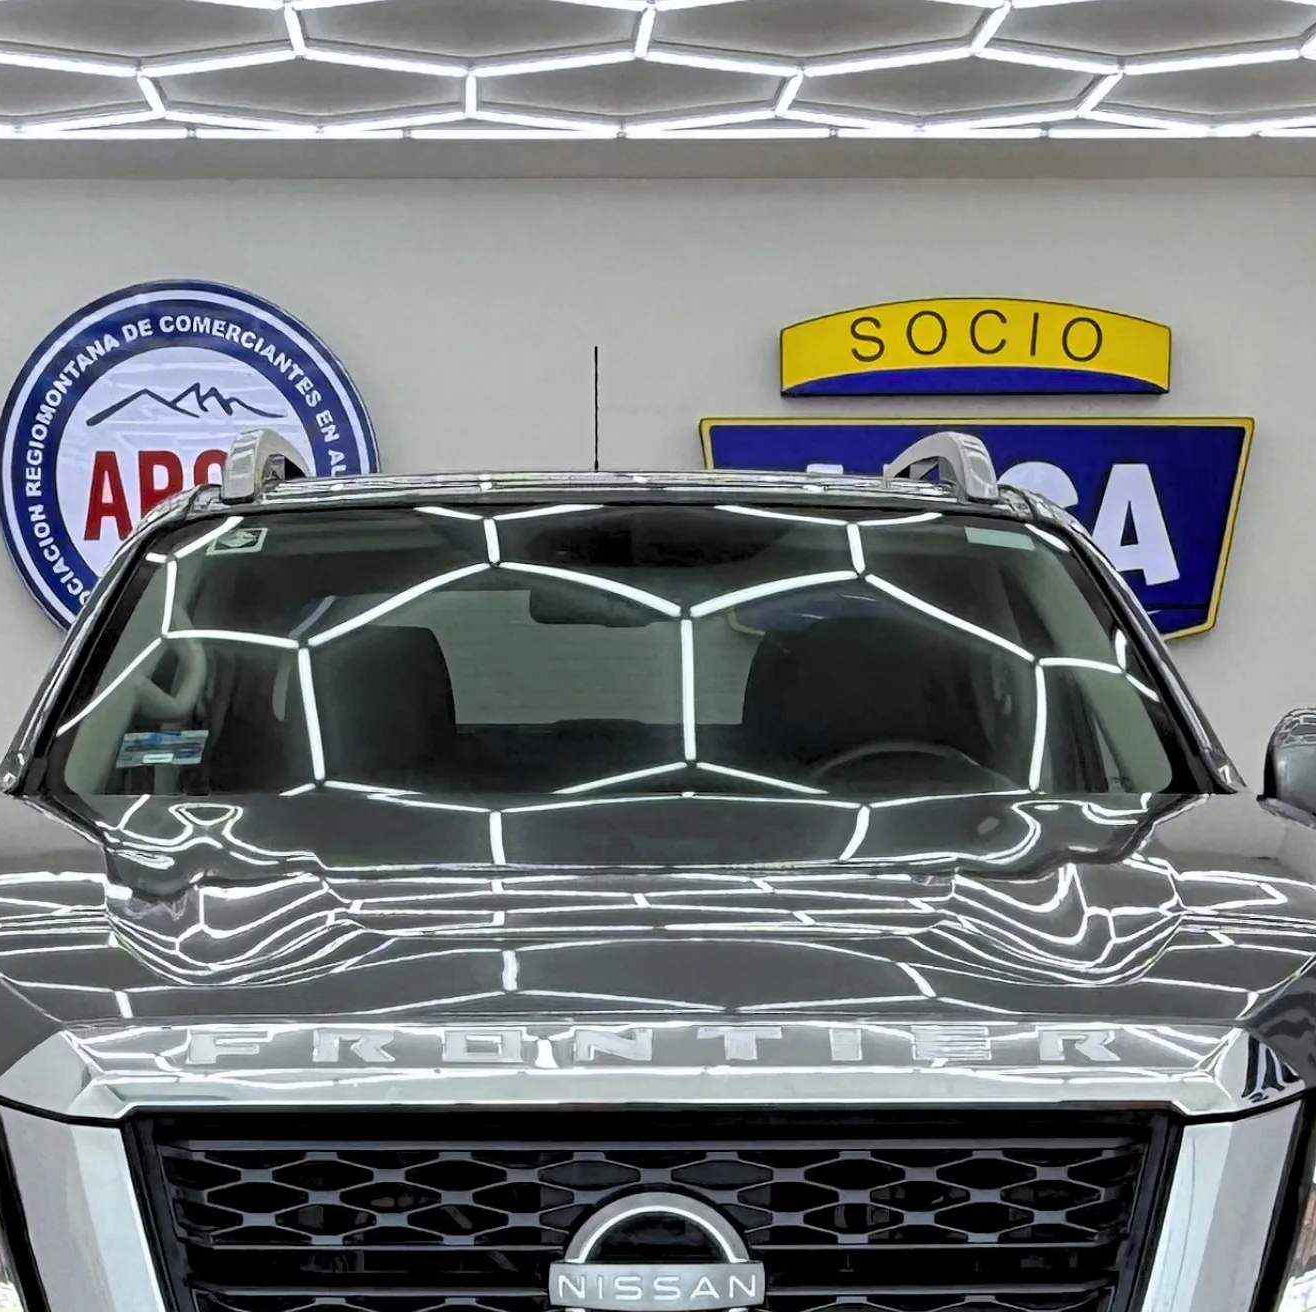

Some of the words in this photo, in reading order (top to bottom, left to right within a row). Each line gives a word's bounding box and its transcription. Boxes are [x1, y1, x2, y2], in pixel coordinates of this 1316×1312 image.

[849, 309, 1104, 362] SOCIO
[26, 333, 120, 498] REGIOMONTANA
[123, 318, 154, 344] DE
[158, 314, 322, 408] COMERCIANTES
[315, 409, 340, 443] EN
[185, 1025, 1121, 1063] FRONTIER
[557, 1274, 756, 1300] NISSAN
